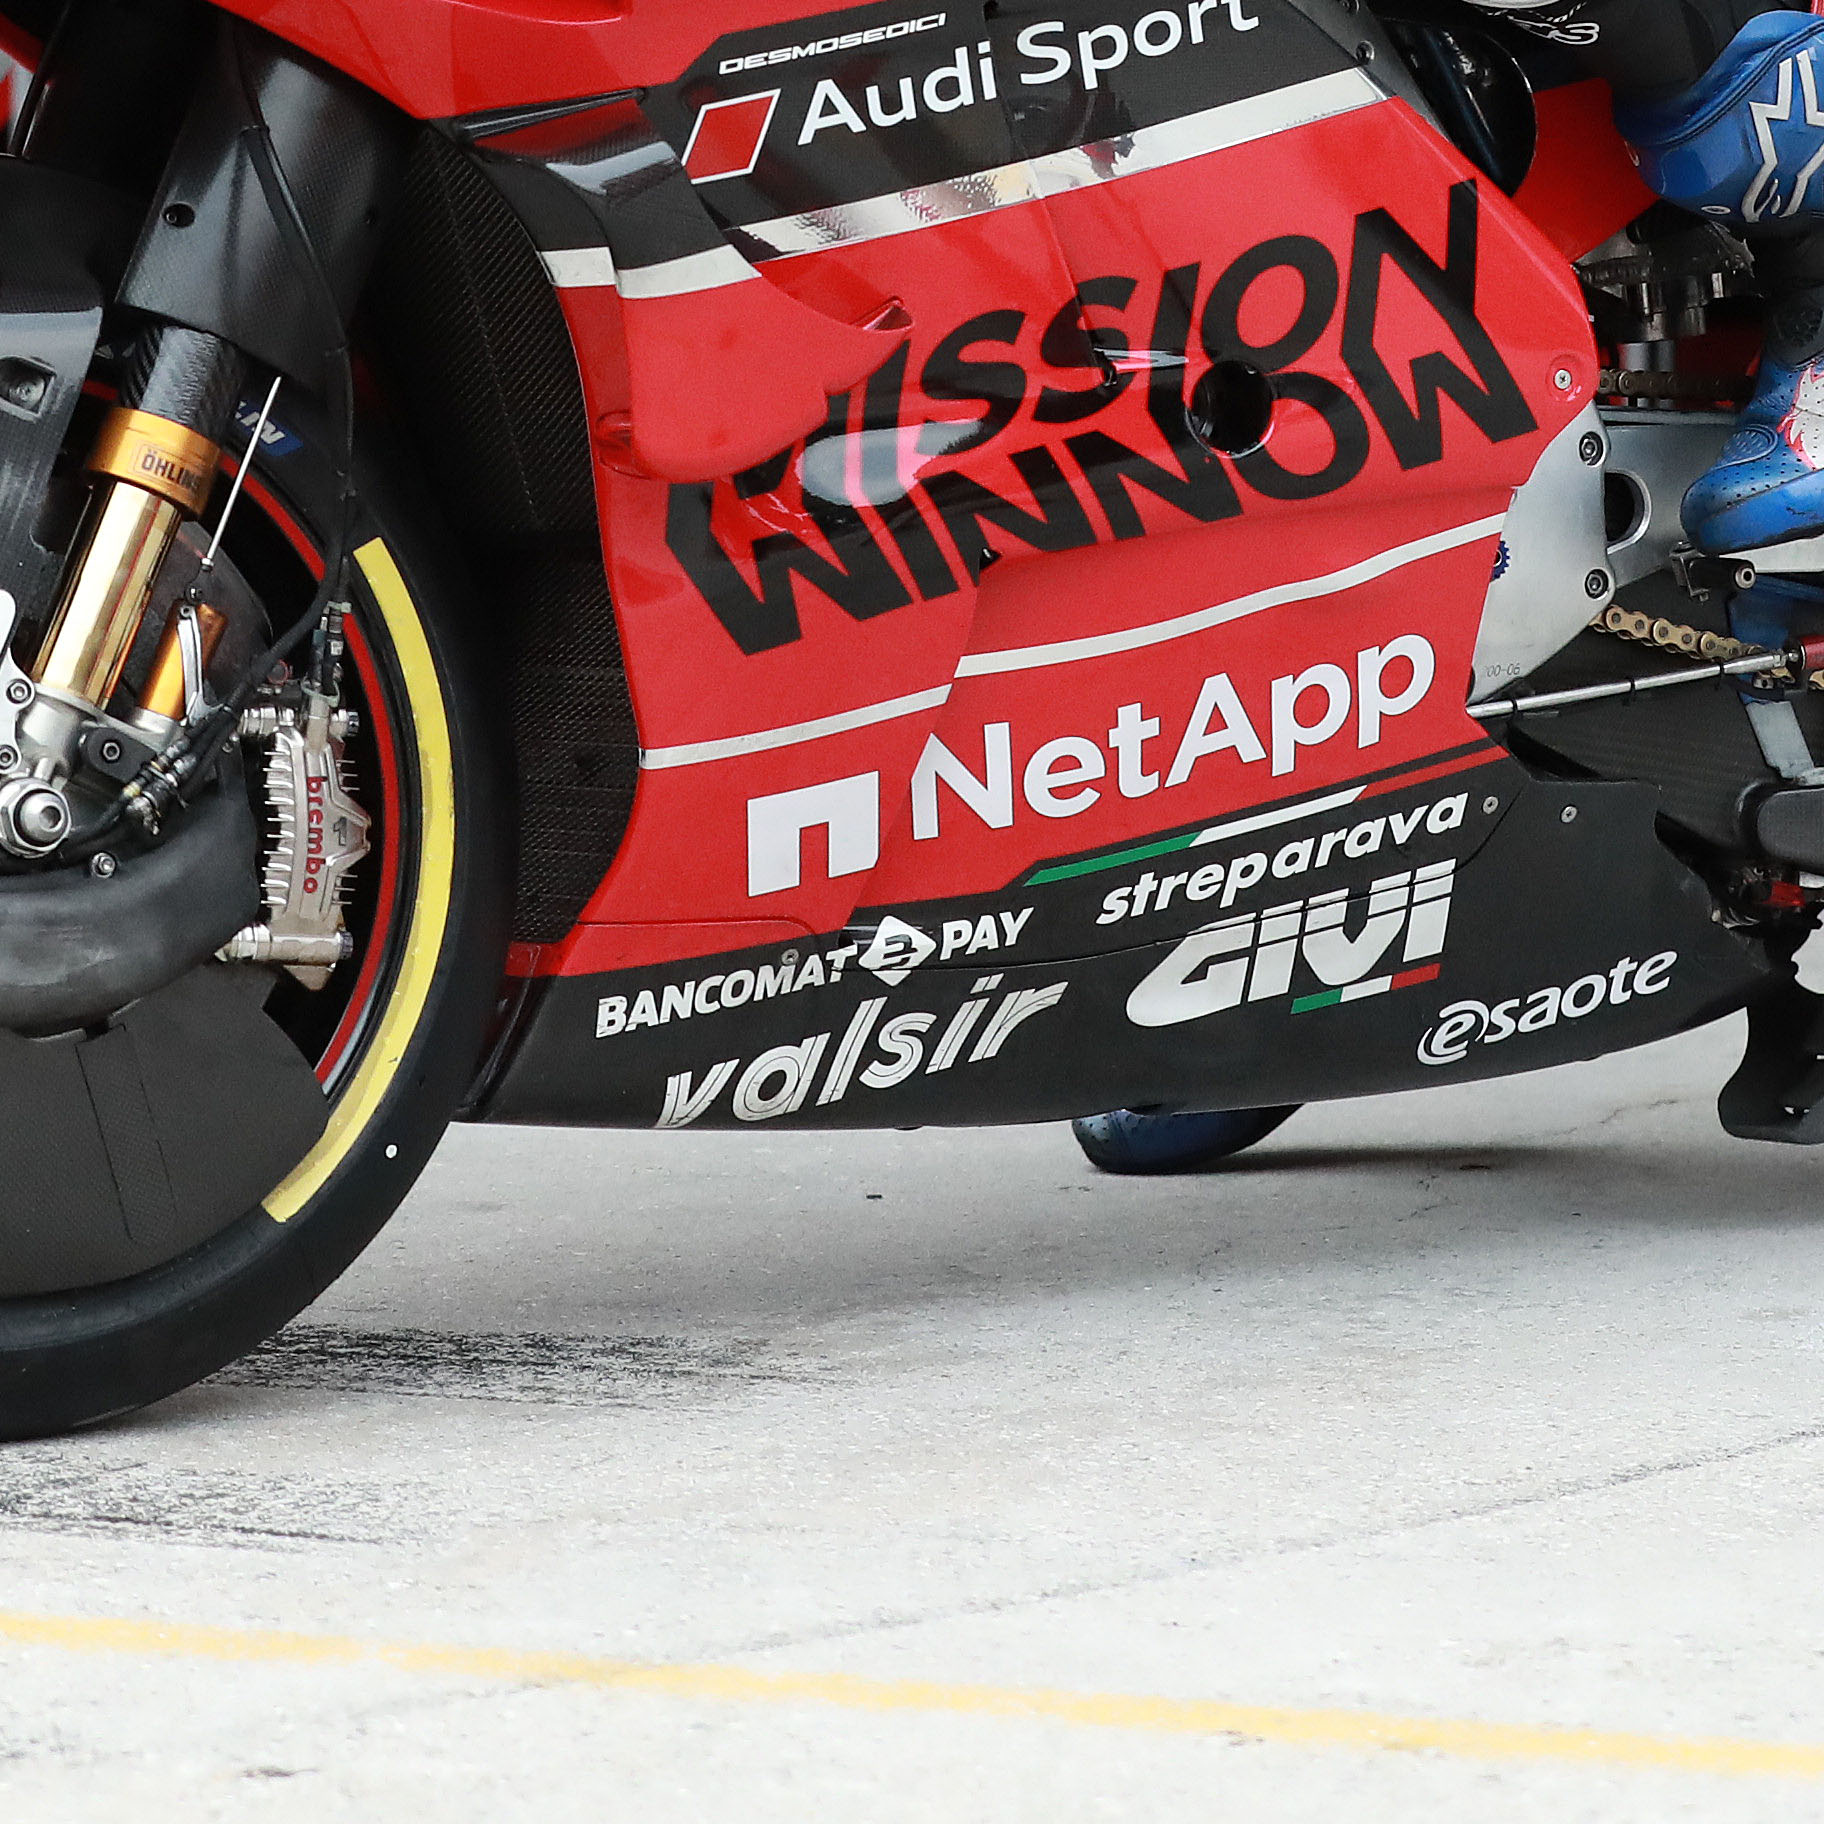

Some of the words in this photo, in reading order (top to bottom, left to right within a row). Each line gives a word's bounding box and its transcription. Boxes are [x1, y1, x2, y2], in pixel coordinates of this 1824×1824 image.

[718, 13, 946, 75] DESMOSEDICI
[796, 43, 998, 146] Audi
[664, 316, 1542, 657] WINNOW
[911, 631, 1437, 842] NetApp
[303, 776, 329, 894] brembo
[1095, 792, 1469, 928] streparava
[595, 943, 857, 1038] BANCOMAT
[940, 906, 1035, 960] PAY
[1126, 858, 1457, 1028] GIVI
[1416, 949, 1677, 1066] esaote
[655, 973, 1069, 1129] valsir
